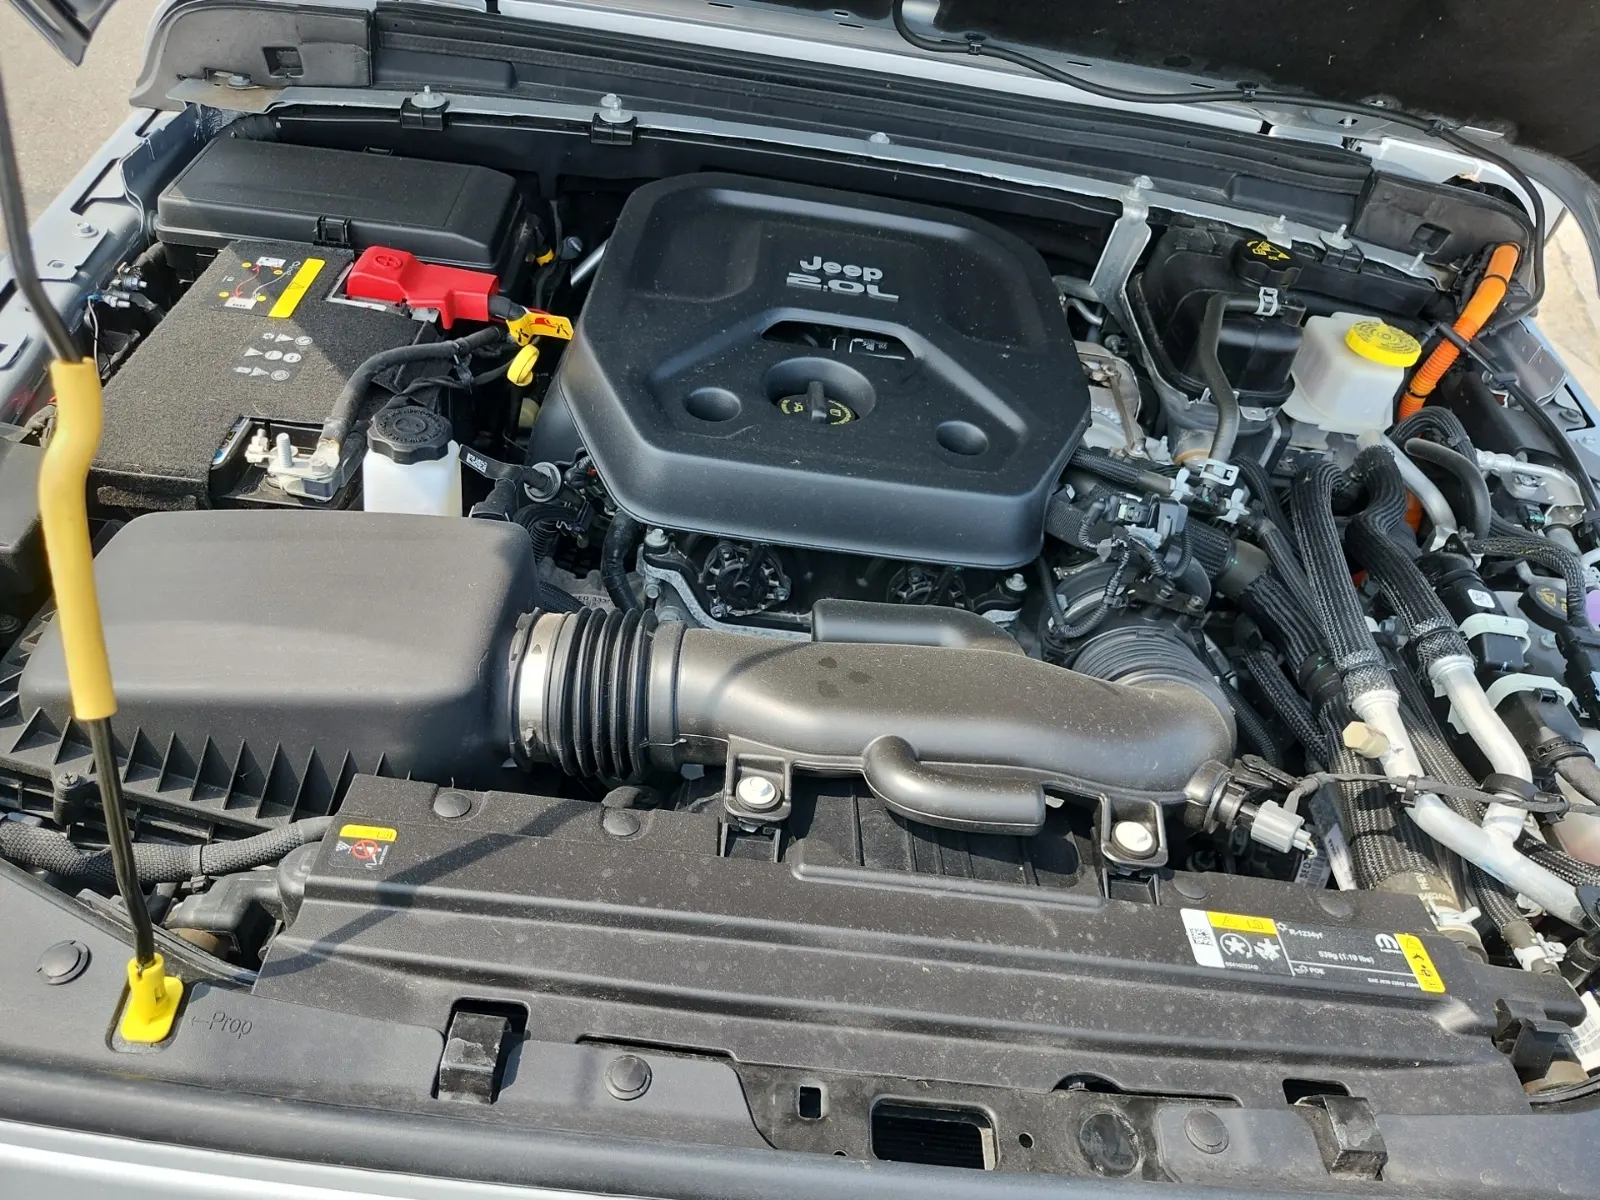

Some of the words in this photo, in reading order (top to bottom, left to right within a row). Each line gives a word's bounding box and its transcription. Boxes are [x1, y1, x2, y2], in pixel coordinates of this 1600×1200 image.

[799, 256, 883, 282] Jeep
[786, 272, 899, 301] 2.0L
[209, 1011, 253, 1040] Prop
